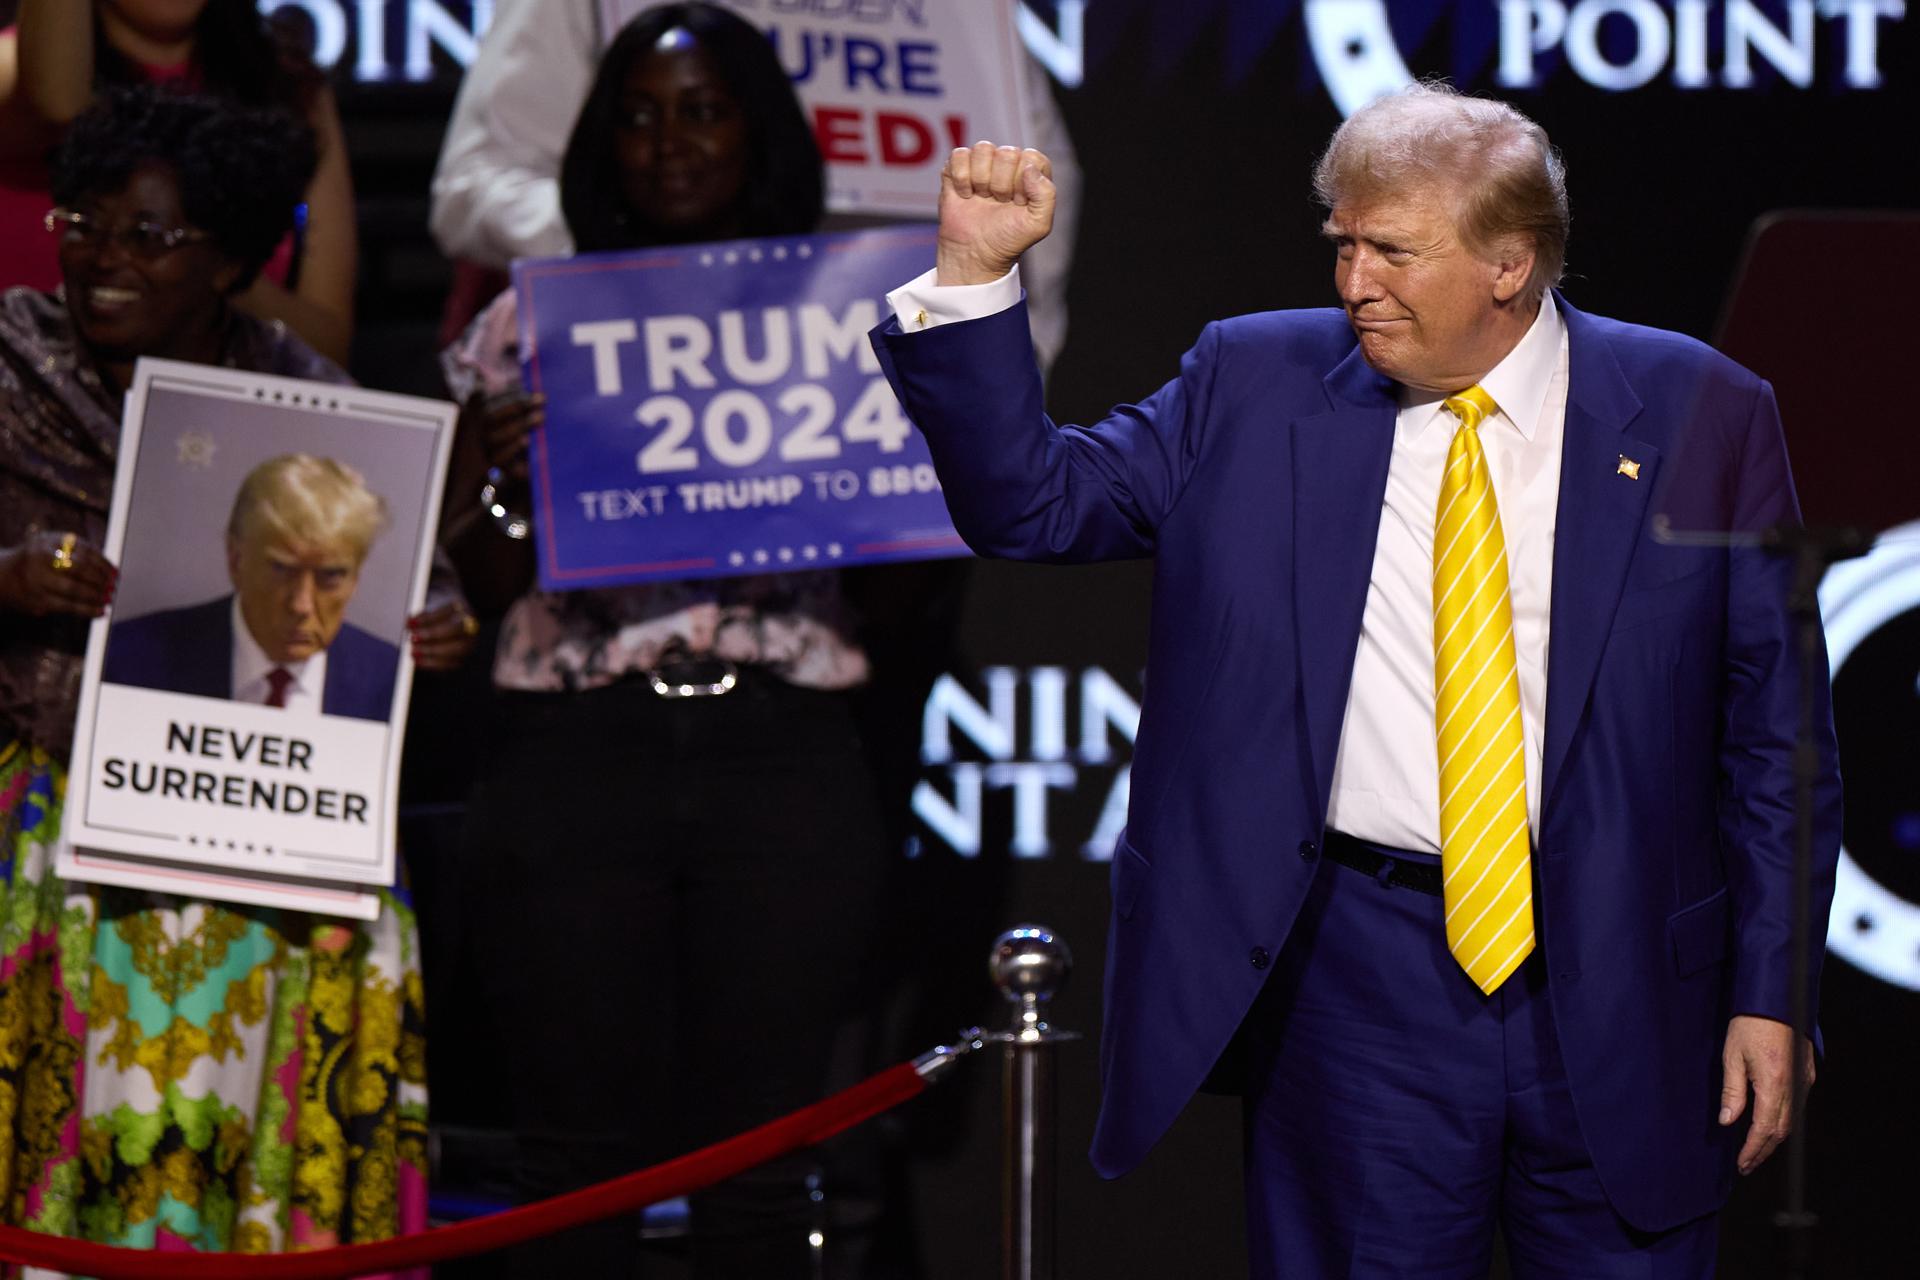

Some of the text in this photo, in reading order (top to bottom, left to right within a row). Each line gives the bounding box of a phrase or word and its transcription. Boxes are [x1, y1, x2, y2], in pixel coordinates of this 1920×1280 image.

[1497, 0, 1905, 90] POINT
[571, 299, 891, 396] TRUM
[635, 378, 911, 473] 2024
[577, 463, 943, 521] TEXT TRUMP TO 880
[168, 721, 313, 771] NEVER
[102, 759, 369, 823] SURRENDER
